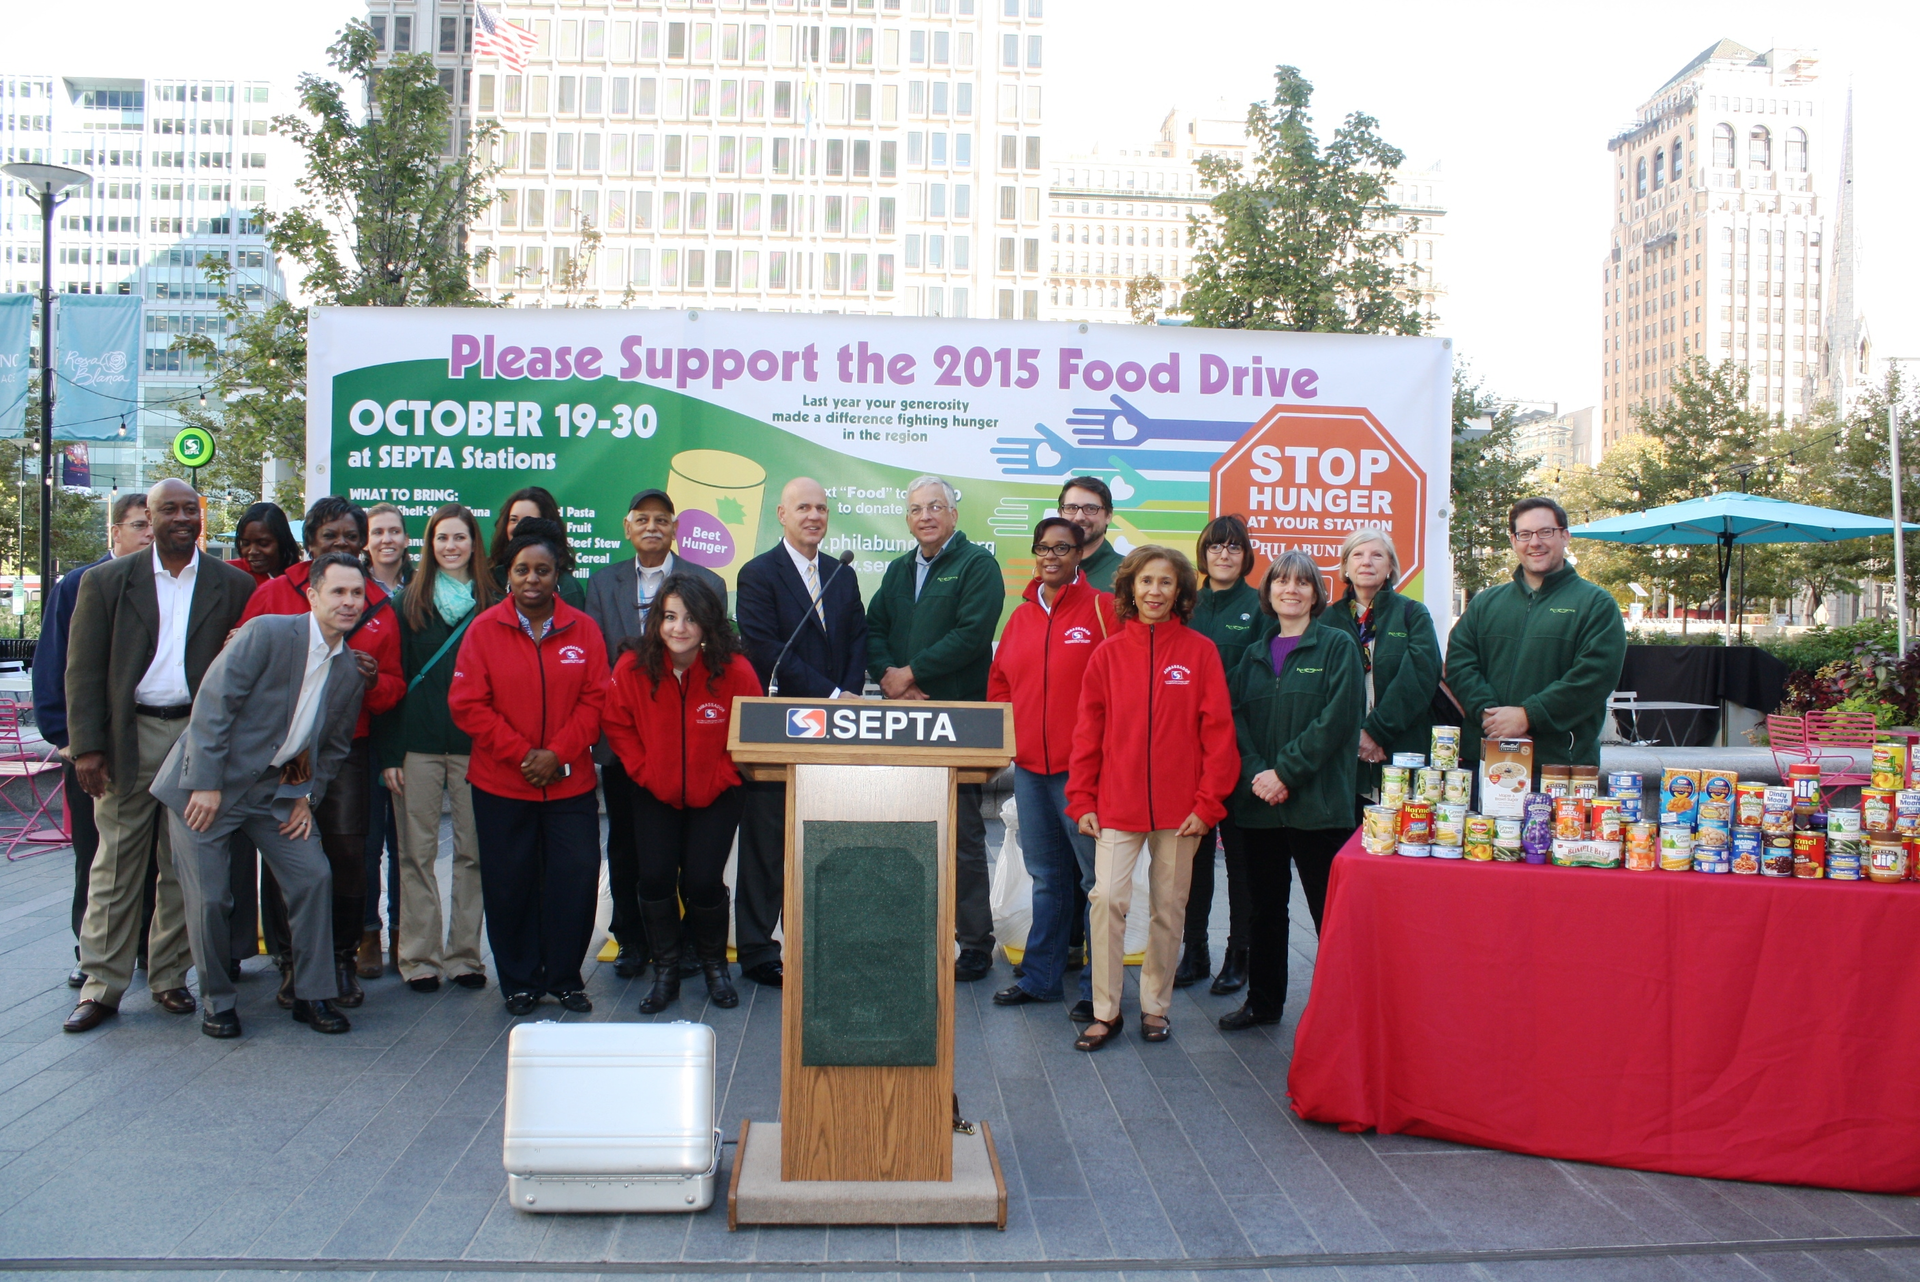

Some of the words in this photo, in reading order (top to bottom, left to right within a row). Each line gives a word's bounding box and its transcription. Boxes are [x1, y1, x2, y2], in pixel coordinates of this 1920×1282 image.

[449, 334, 603, 379] Please
[619, 334, 818, 389] Support
[837, 341, 917, 386] the
[933, 345, 1041, 389] 2015
[1059, 347, 1180, 394] Food
[1200, 353, 1319, 399] Drive
[803, 394, 828, 407] Last
[832, 398, 861, 410] year
[866, 398, 896, 411] your
[900, 398, 970, 413] generosity
[349, 399, 543, 437] OCTOBER
[555, 402, 658, 439] 19-30
[772, 410, 809, 422] made
[814, 413, 821, 423] a
[825, 411, 894, 425] difference
[898, 412, 948, 429] fighting
[952, 414, 999, 430] hunger
[843, 428, 855, 440] in
[860, 428, 881, 441] the
[885, 430, 928, 444] region
[348, 447, 371, 468] at
[379, 445, 455, 469] SEPTA
[462, 446, 556, 470] Stations
[1250, 444, 1390, 486] STOP
[349, 488, 388, 501] WHAT
[391, 488, 410, 501] TO
[413, 489, 459, 502] BRING:
[1250, 486, 1393, 514] HUNGER
[566, 506, 596, 518] Pasta
[838, 502, 852, 514] to
[856, 502, 903, 516] donate
[566, 522, 592, 533] Fruit
[1247, 516, 1268, 528] AT
[1274, 517, 1319, 530] YOUR
[1324, 518, 1393, 532] STATION
[692, 526, 721, 542] Beet
[567, 537, 592, 548] Beef
[594, 537, 621, 550] Stew
[682, 536, 728, 554] Hunger
[575, 553, 610, 564] Cereal
[832, 709, 957, 742] SEPTA
[1768, 790, 1787, 798] Dinty
[1794, 780, 1818, 798] Jif
[1874, 854, 1896, 867] Jif
